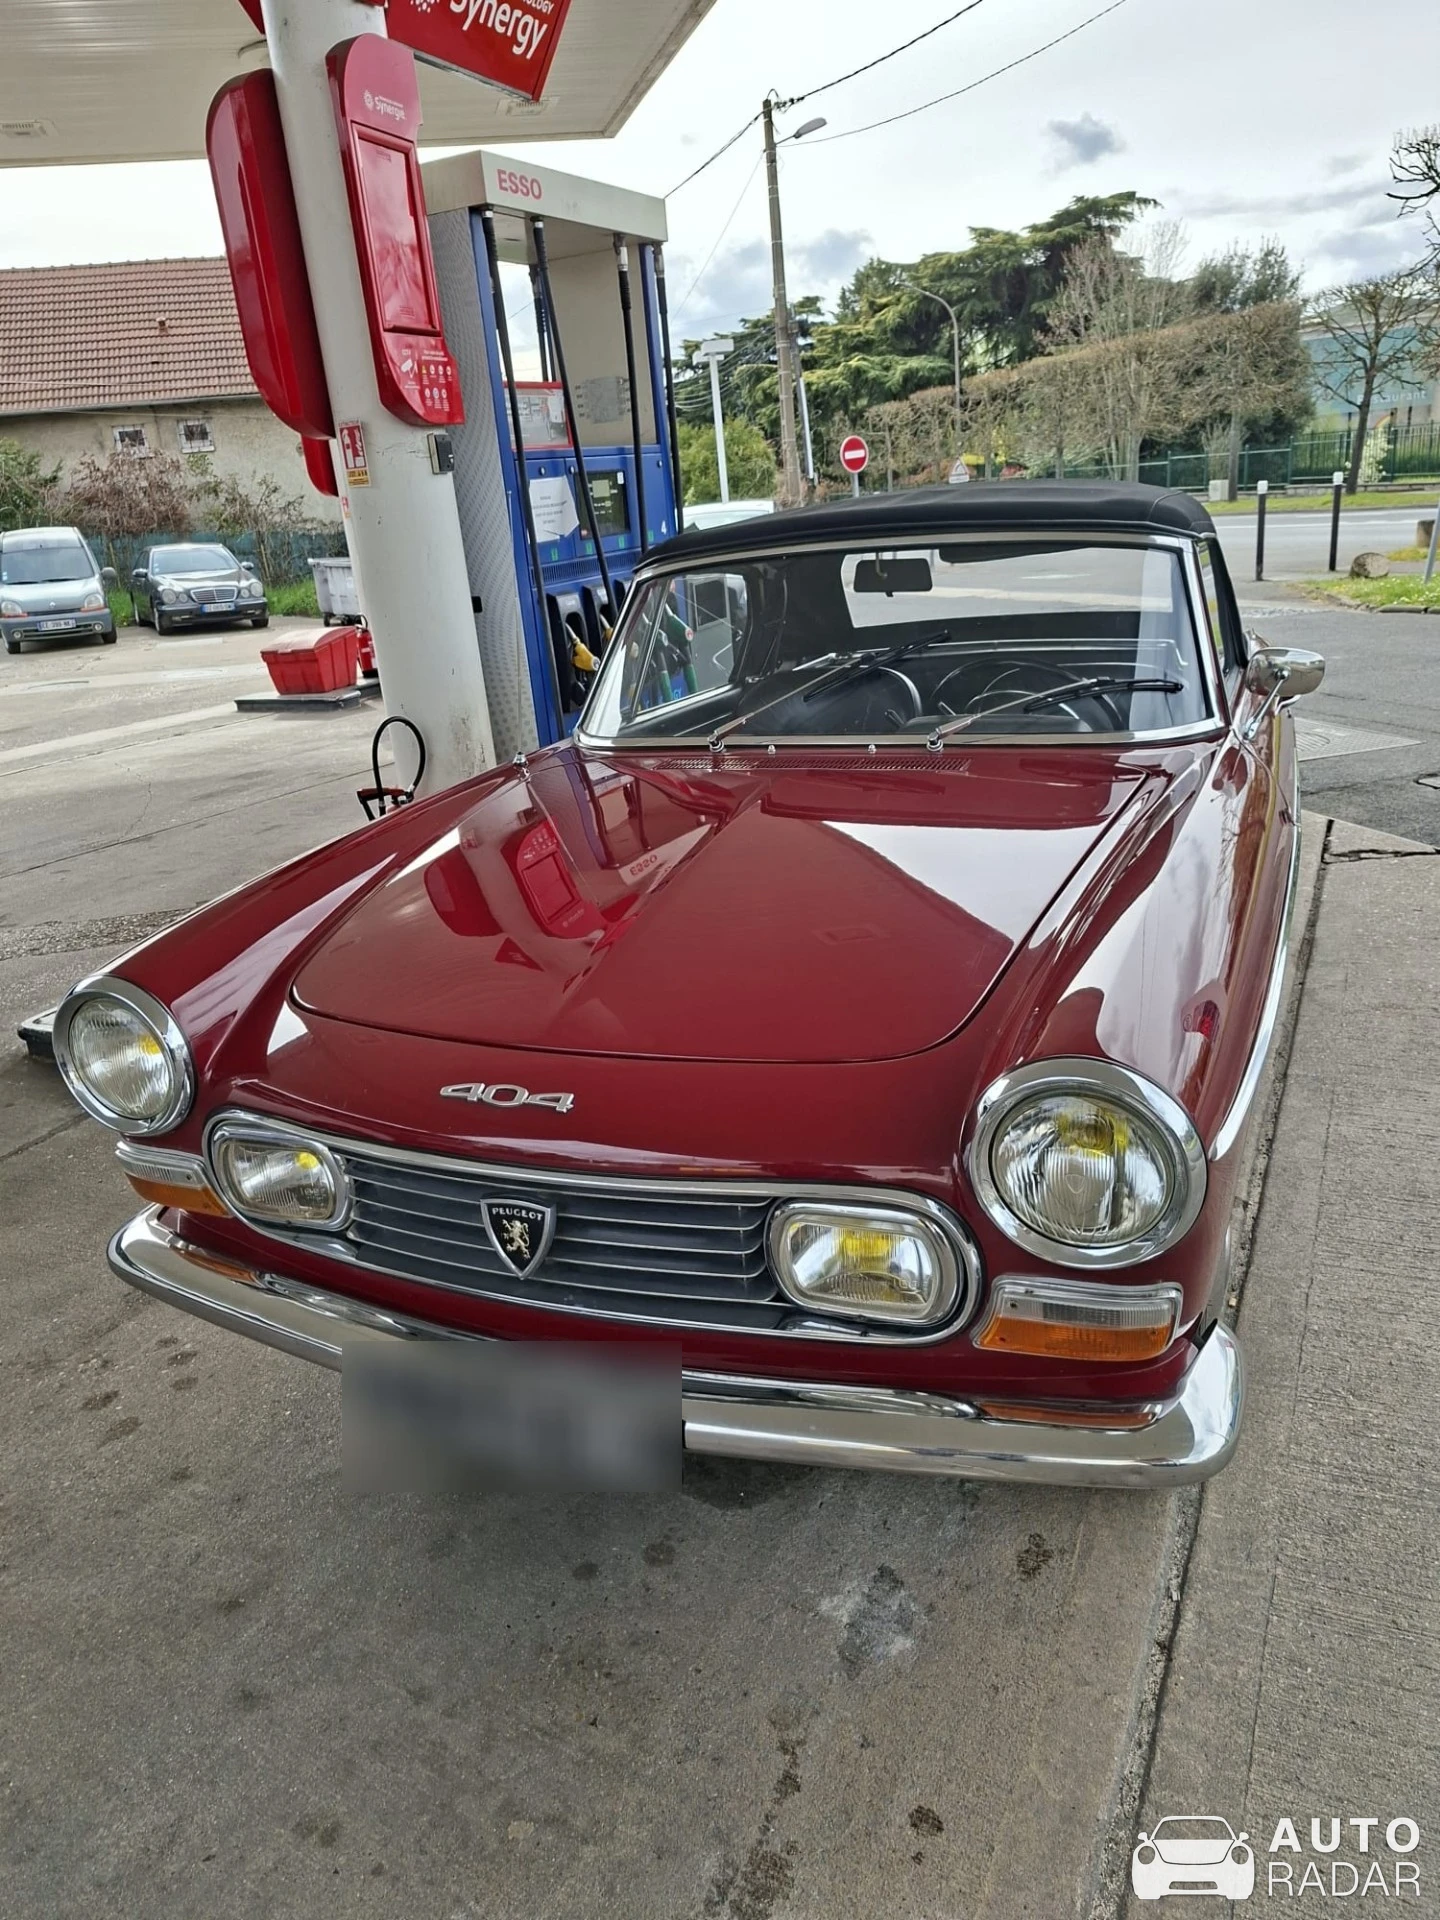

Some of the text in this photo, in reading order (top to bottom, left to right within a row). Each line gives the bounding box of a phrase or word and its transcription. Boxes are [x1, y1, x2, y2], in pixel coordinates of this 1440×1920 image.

[496, 168, 542, 200] ESSO
[439, 1082, 575, 1113] 404
[491, 1207, 543, 1221] PEUGEOT
